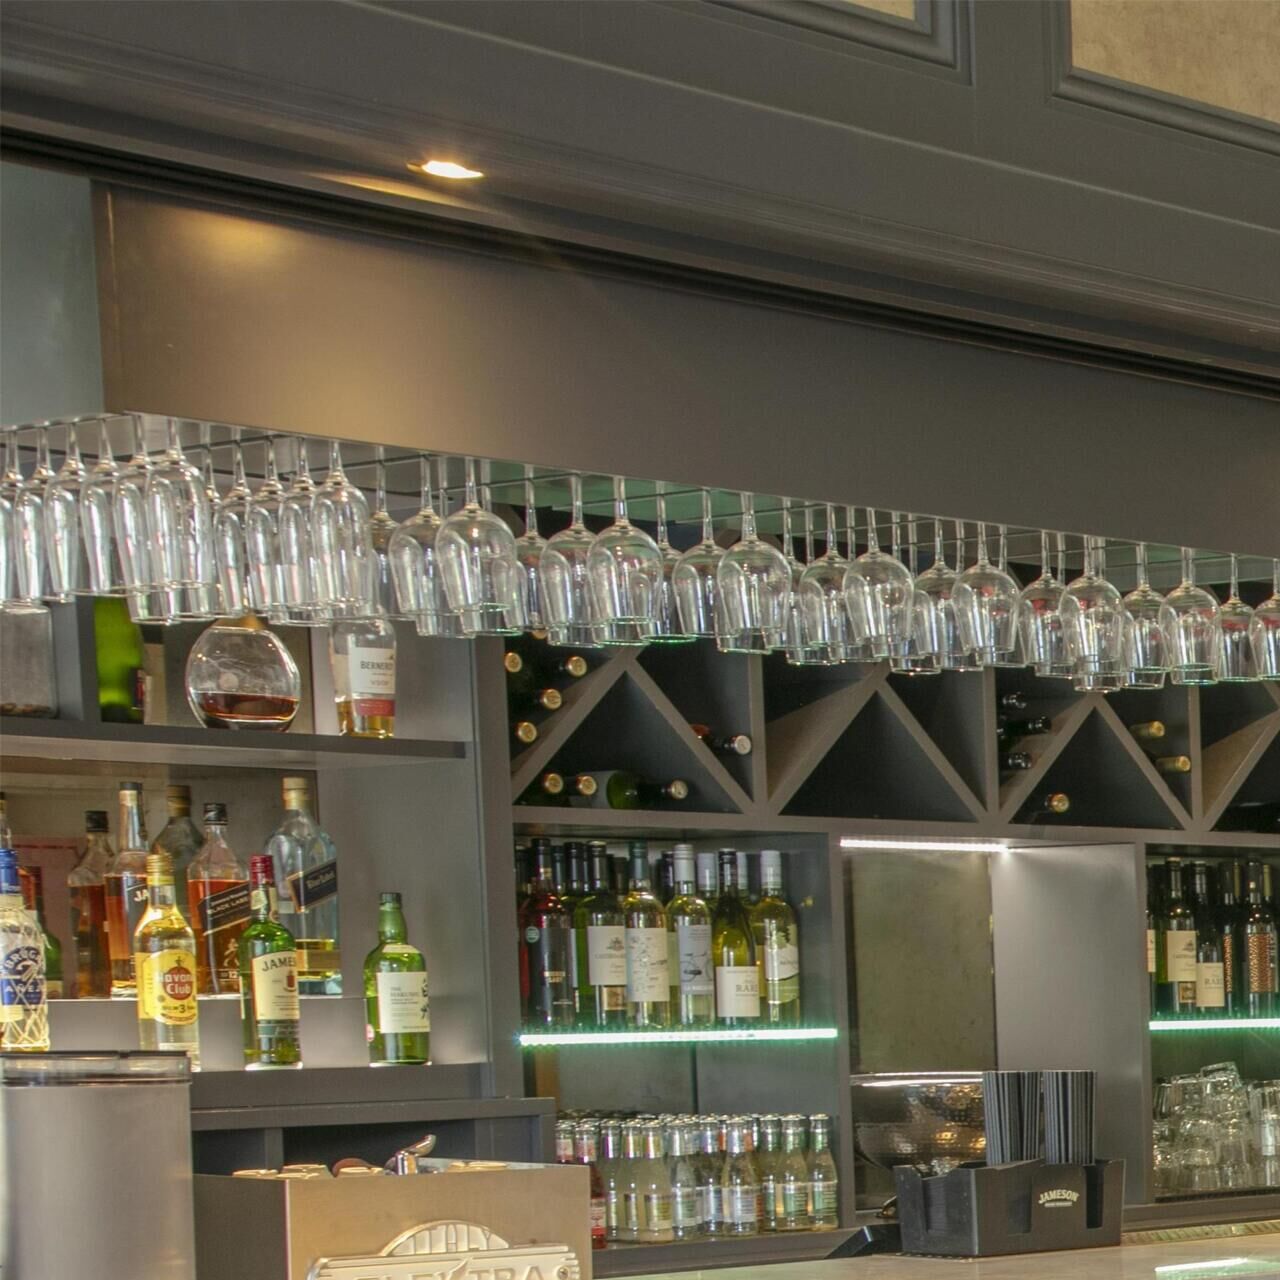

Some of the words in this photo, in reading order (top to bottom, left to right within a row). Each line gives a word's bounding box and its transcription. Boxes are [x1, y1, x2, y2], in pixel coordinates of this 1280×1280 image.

[134, 888, 150, 902] JA
[261, 955, 297, 972] JAME
[166, 983, 191, 995] Club
[1038, 1189, 1080, 1204] JAMESON
